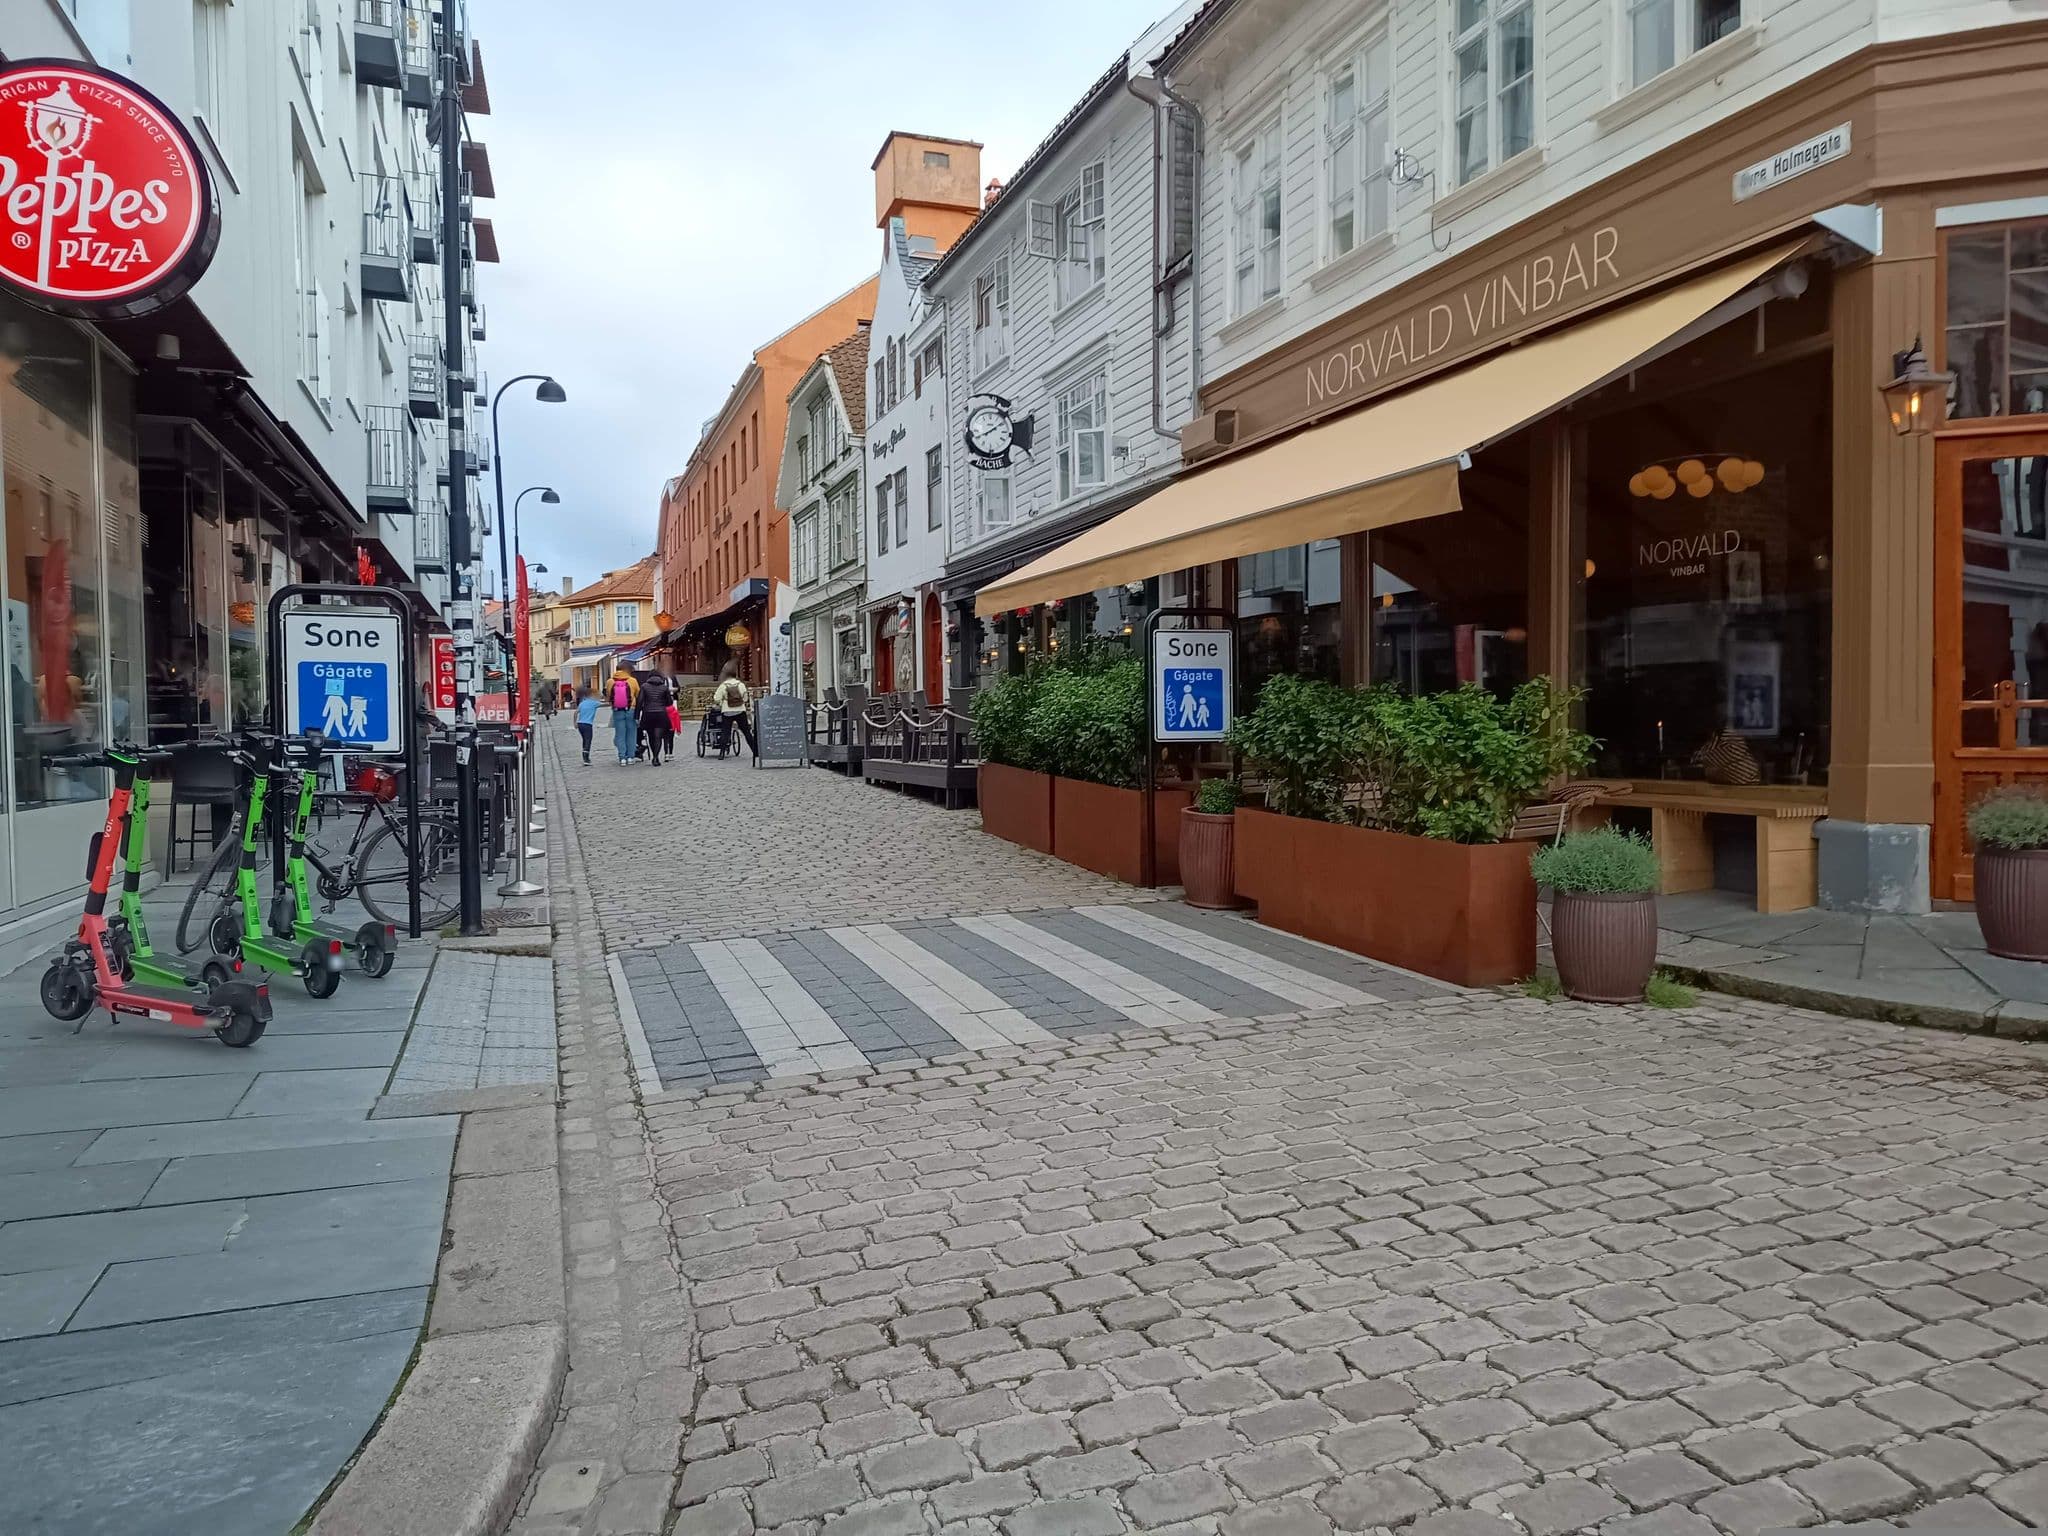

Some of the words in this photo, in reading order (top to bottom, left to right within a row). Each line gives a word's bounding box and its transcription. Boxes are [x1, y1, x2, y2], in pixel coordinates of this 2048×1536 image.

[79, 84, 122, 109] PIZZA
[126, 106, 166, 143] SINCE
[162, 147, 183, 177] 1970
[1773, 134, 1841, 177] Holmegate
[56, 236, 151, 272] PIZZA
[1306, 304, 1453, 406] NORVALD
[1463, 226, 1619, 337] VINBAR
[1639, 529, 1741, 566] NORVALD
[1670, 564, 1705, 577] VINBAR
[304, 622, 380, 648] Sone
[1168, 637, 1218, 657] Sone
[313, 664, 373, 679] Gågate
[1173, 670, 1214, 684] Gågate
